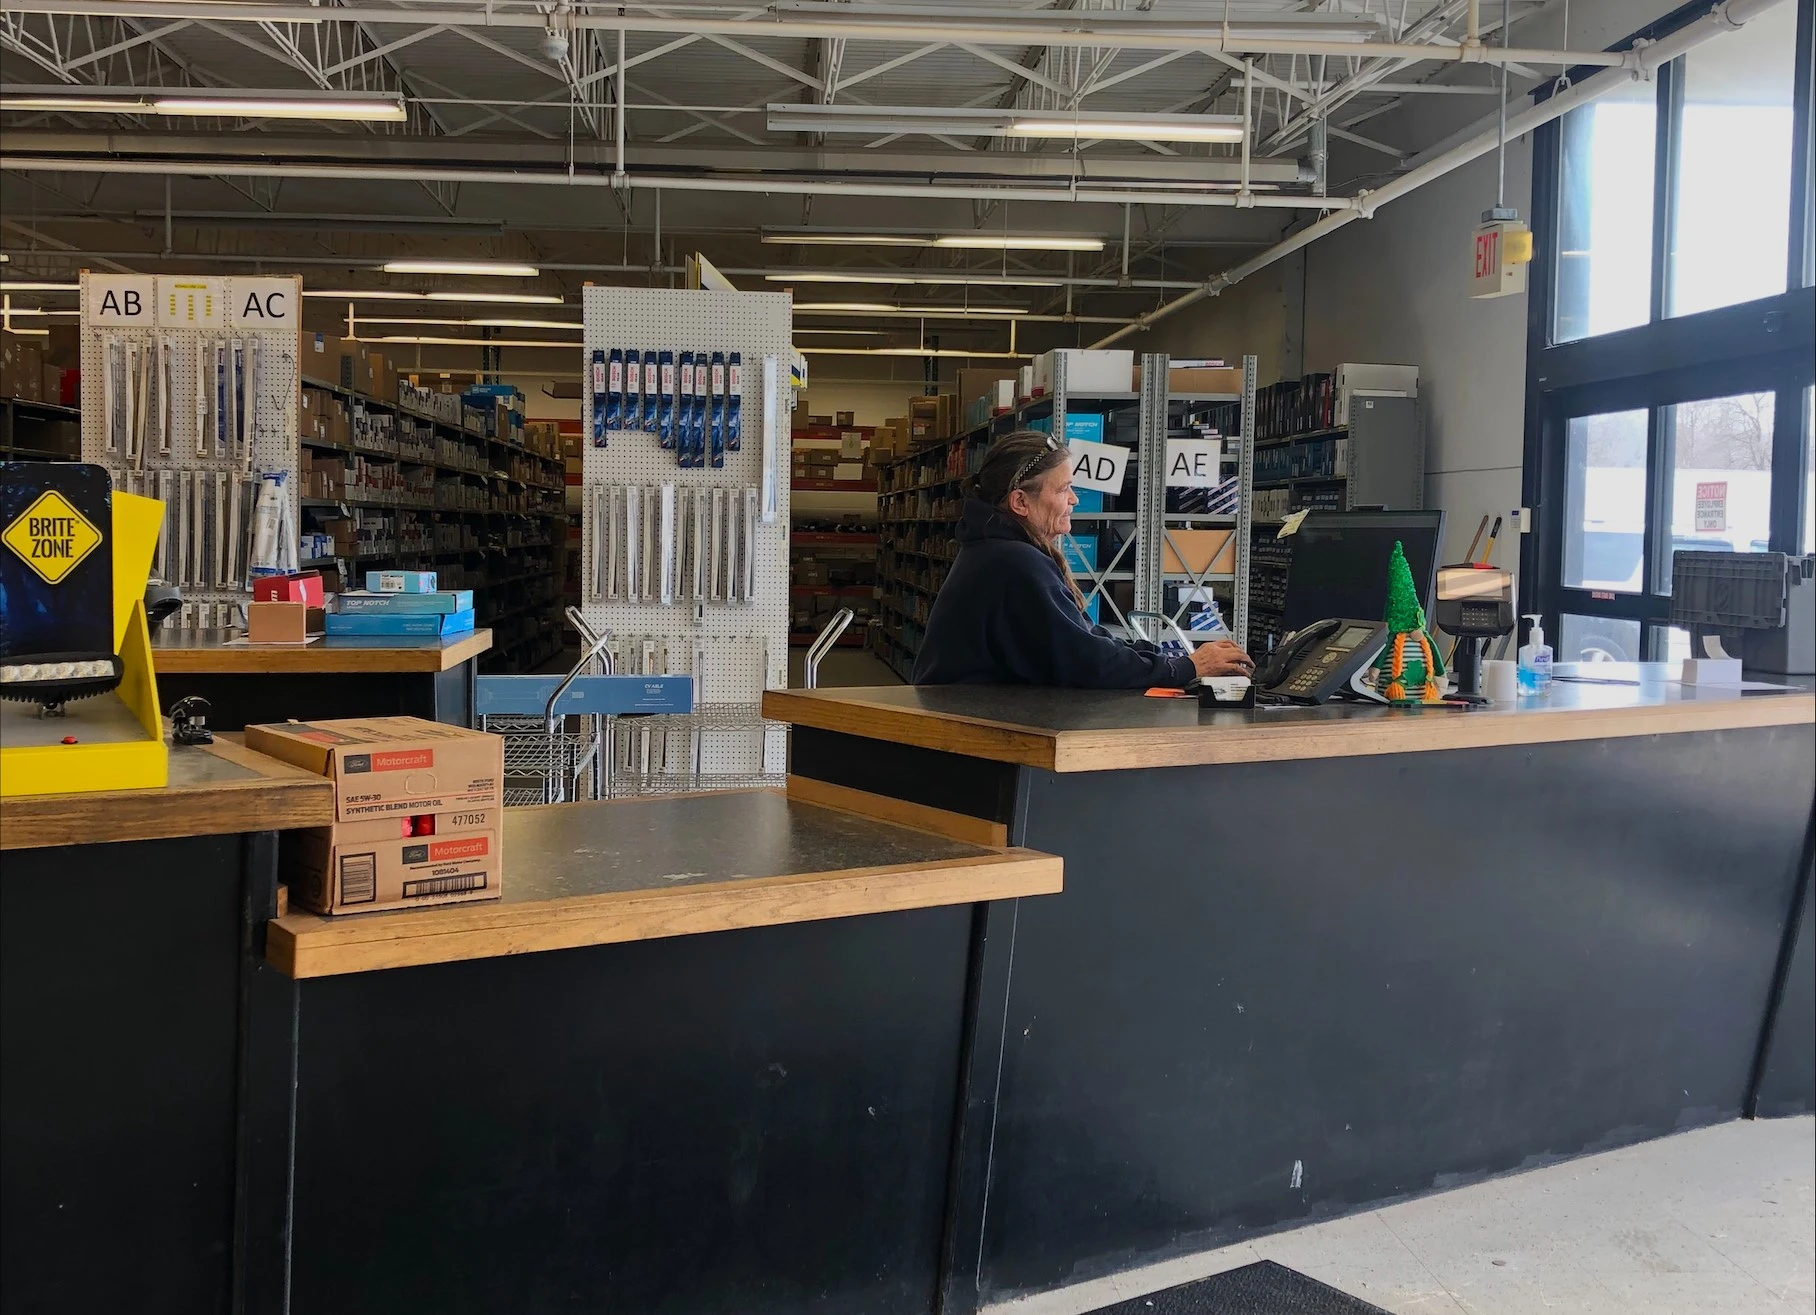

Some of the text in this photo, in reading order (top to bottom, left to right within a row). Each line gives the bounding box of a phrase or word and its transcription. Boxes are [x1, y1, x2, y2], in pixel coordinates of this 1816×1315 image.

[1476, 232, 1498, 278] EXIT
[100, 290, 142, 316] AB
[242, 292, 284, 318] AC
[1072, 454, 1115, 481] AD
[1171, 452, 1208, 476] AE
[32, 539, 74, 558] ZONE
[376, 754, 427, 767] Motorcraft
[346, 805, 384, 814] SYNTHETIC
[386, 802, 408, 811] BLEND
[409, 800, 432, 808] MOTOR
[360, 794, 381, 802] 5W-30
[452, 813, 485, 826] 477052
[434, 843, 483, 856] Motorcraft
